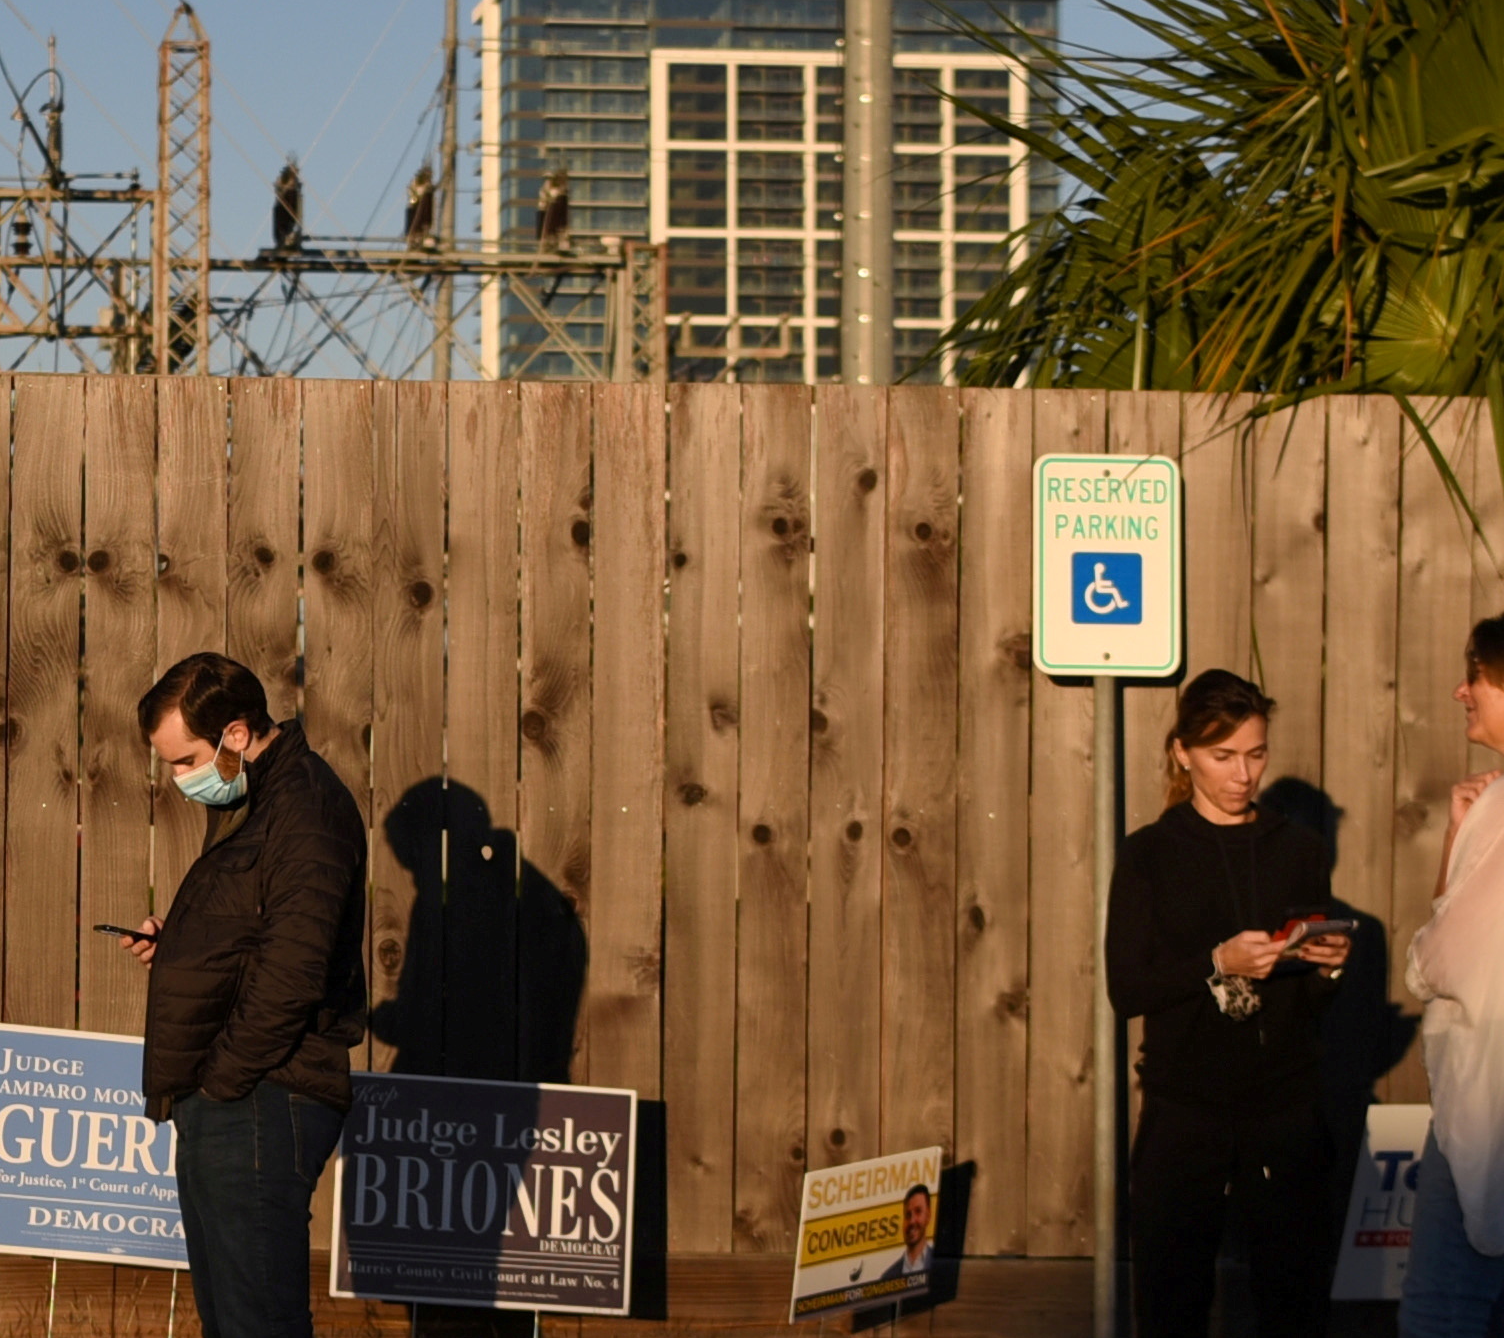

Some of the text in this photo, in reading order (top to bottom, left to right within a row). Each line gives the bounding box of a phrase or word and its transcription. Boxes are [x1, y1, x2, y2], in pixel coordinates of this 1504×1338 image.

[1047, 477, 1167, 504] RESERVED
[1055, 514, 1159, 541] PARKING
[94, 1087, 143, 1106] MON
[355, 1105, 623, 1168] Judge Lesley
[17, 1171, 67, 1190] Justice,
[71, 1176, 86, 1190] 1st
[89, 1177, 129, 1194] Court
[132, 1181, 148, 1195] of
[808, 1156, 937, 1209] SCHEIRMAN
[351, 1152, 622, 1244] BRIONES
[27, 1206, 186, 1239] DEMOCRA
[807, 1214, 901, 1255] CONGRESS
[539, 1239, 620, 1257] DEMOCRAT
[347, 1261, 620, 1290] Harris County Civil Court at Law No. 4
